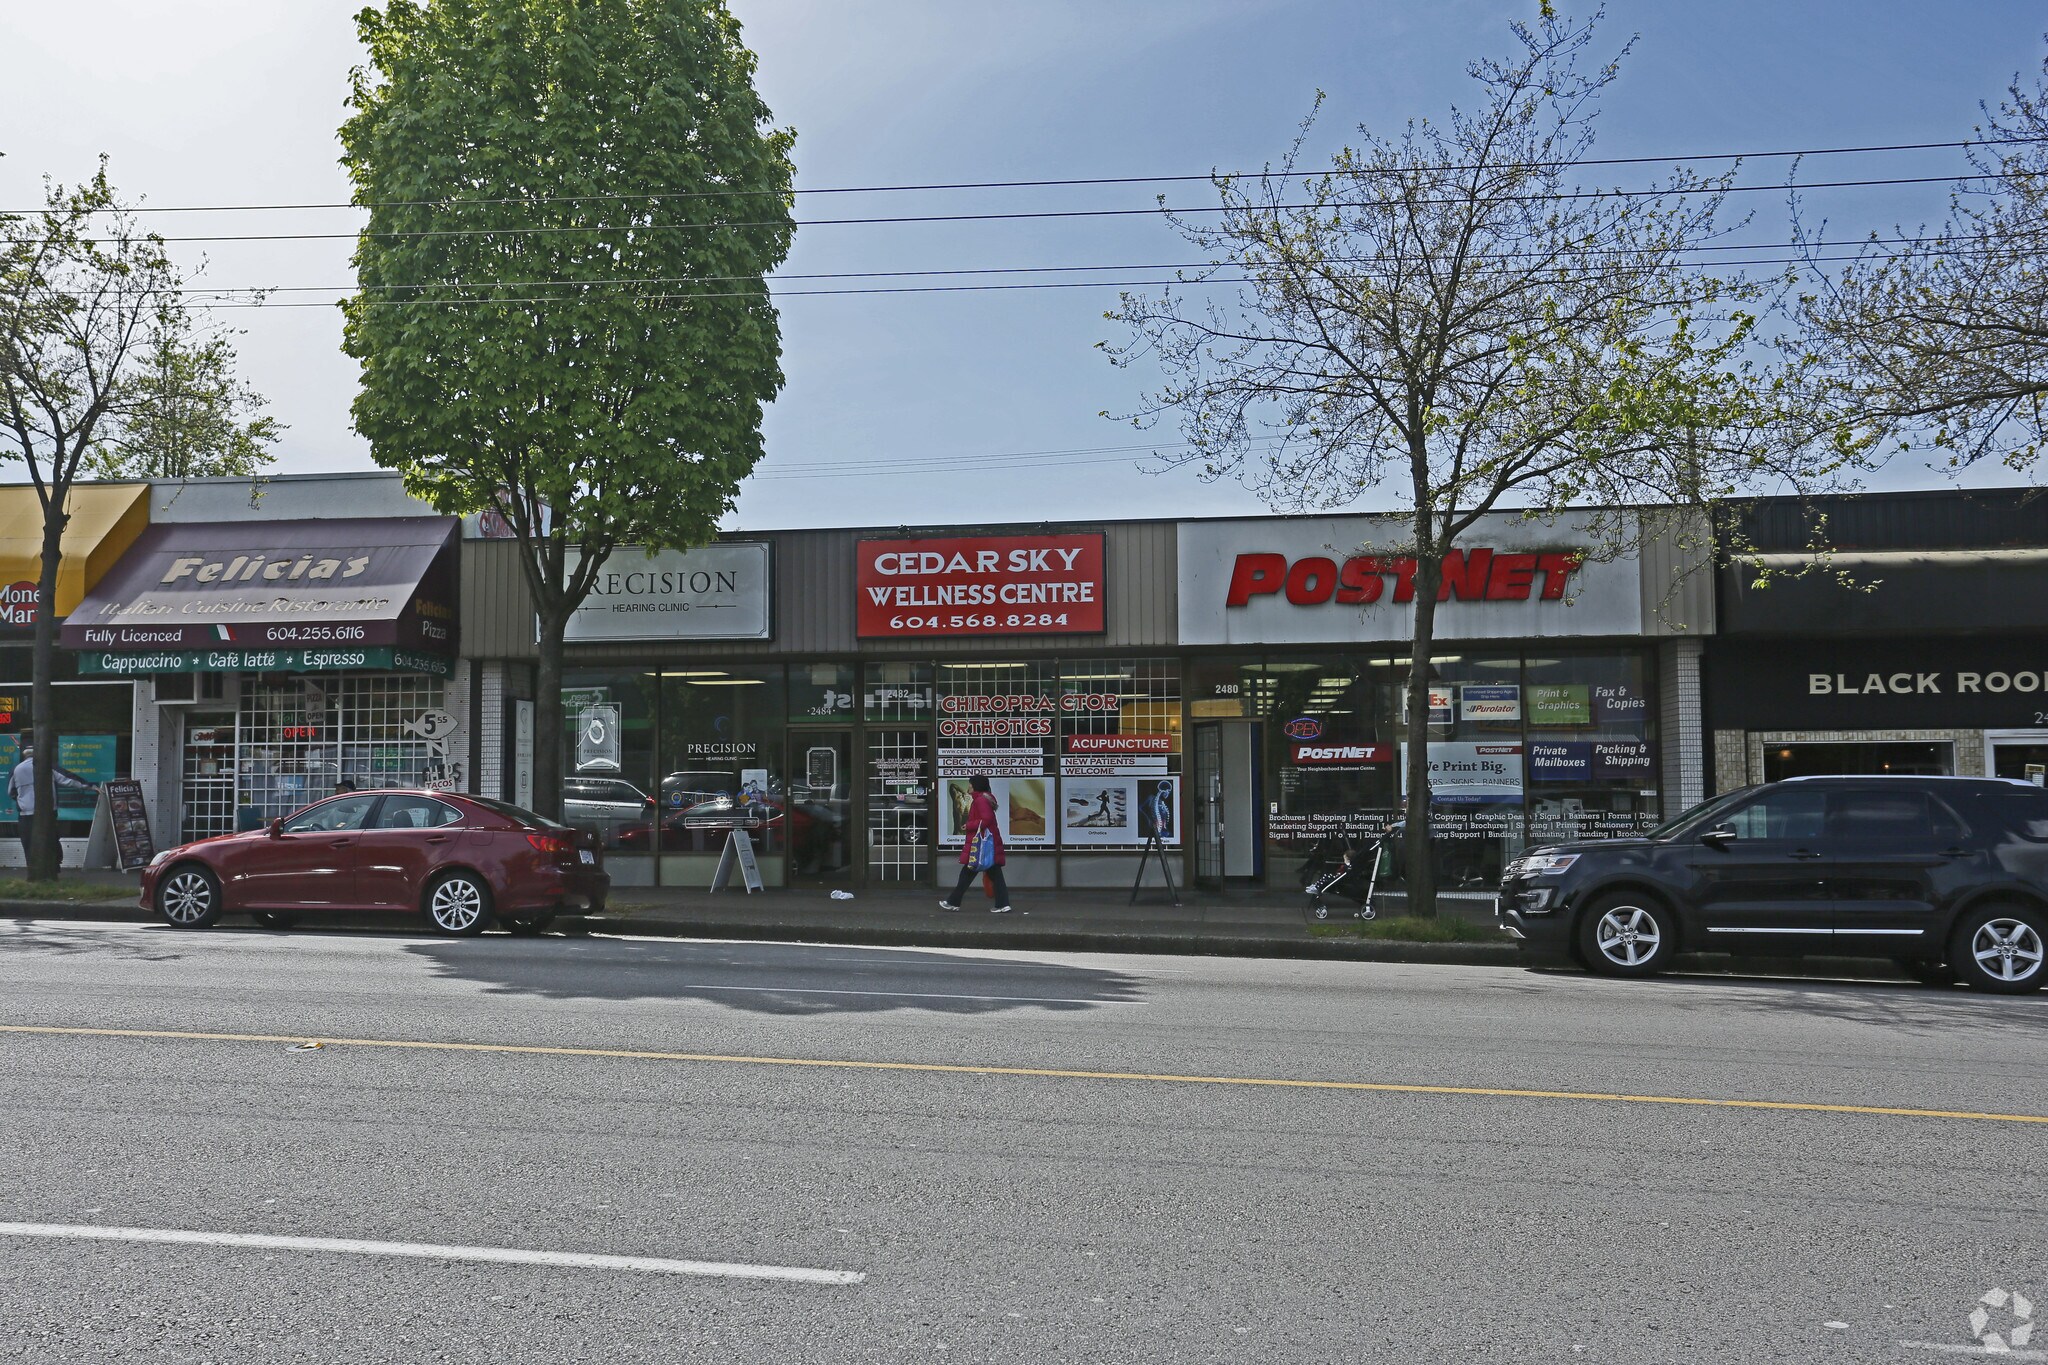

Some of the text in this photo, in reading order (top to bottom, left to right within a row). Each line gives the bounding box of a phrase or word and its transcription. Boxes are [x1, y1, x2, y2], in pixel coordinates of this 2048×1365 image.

[874, 547, 1084, 575] CEDAR SKY
[0, 585, 40, 603] Mone
[866, 581, 1095, 607] WELLNESS CENTRE
[99, 597, 390, 616] Italian Cuisine Ristorante
[611, 602, 690, 613] HEARING CLINIC
[0, 604, 39, 623] Mar
[889, 613, 1069, 629] 604.568.8284
[266, 626, 366, 641] 604.255.6116
[422, 620, 447, 640] Pizza
[85, 628, 183, 646] Fully Licenced
[102, 650, 365, 674] Cappuccino Café latté Espresso
[1808, 670, 2048, 695] BLACK ROO
[887, 689, 909, 698] 2482
[1215, 684, 1239, 694] 2480
[1537, 689, 1569, 698] Print &
[1595, 686, 1627, 697] Fax &
[1474, 704, 1516, 713] Purolator
[1537, 701, 1580, 711] Graphics
[1606, 698, 1646, 710] Copies
[811, 707, 832, 715] 2484
[283, 726, 316, 739] OPEN
[940, 718, 1052, 736] ORTHOTICS
[1284, 721, 1323, 737] OPEN
[687, 743, 757, 754] PRECISION
[1071, 739, 1169, 749] ACUPUNCTURE
[1595, 743, 1648, 756] Packing &
[1297, 746, 1376, 760] POSTNET
[1532, 746, 1568, 755] Private
[942, 758, 1040, 766] ICBC, WCB, MSP AND
[1534, 757, 1586, 767] Mailboxes
[1604, 755, 1651, 767] Shipping
[943, 768, 994, 776] EXTENDED
[1065, 767, 1115, 775] WELCOME
[1428, 760, 1507, 775] e Print Big.
[426, 779, 453, 789] TACOS
[1482, 777, 1521, 786] BANNERS
[1312, 814, 1347, 822] Shipping
[1354, 813, 1384, 822] Printing
[1434, 813, 1468, 821] Copying
[1474, 813, 1506, 822] Graphic
[1539, 813, 1561, 821] Signs
[1568, 812, 1600, 820] Banners
[1268, 823, 1307, 831] Marketing
[1308, 823, 1338, 831] Support
[1345, 823, 1375, 831] Binding
[1432, 822, 1463, 831] randing
[1515, 822, 1548, 831] Shping
[1556, 821, 1587, 830] Printing
[1594, 821, 1634, 830] Stationery
[1268, 832, 1290, 840] Signs
[1449, 831, 1481, 839] Support
[1488, 831, 1518, 839] Binding
[1573, 830, 1609, 839] Branding
